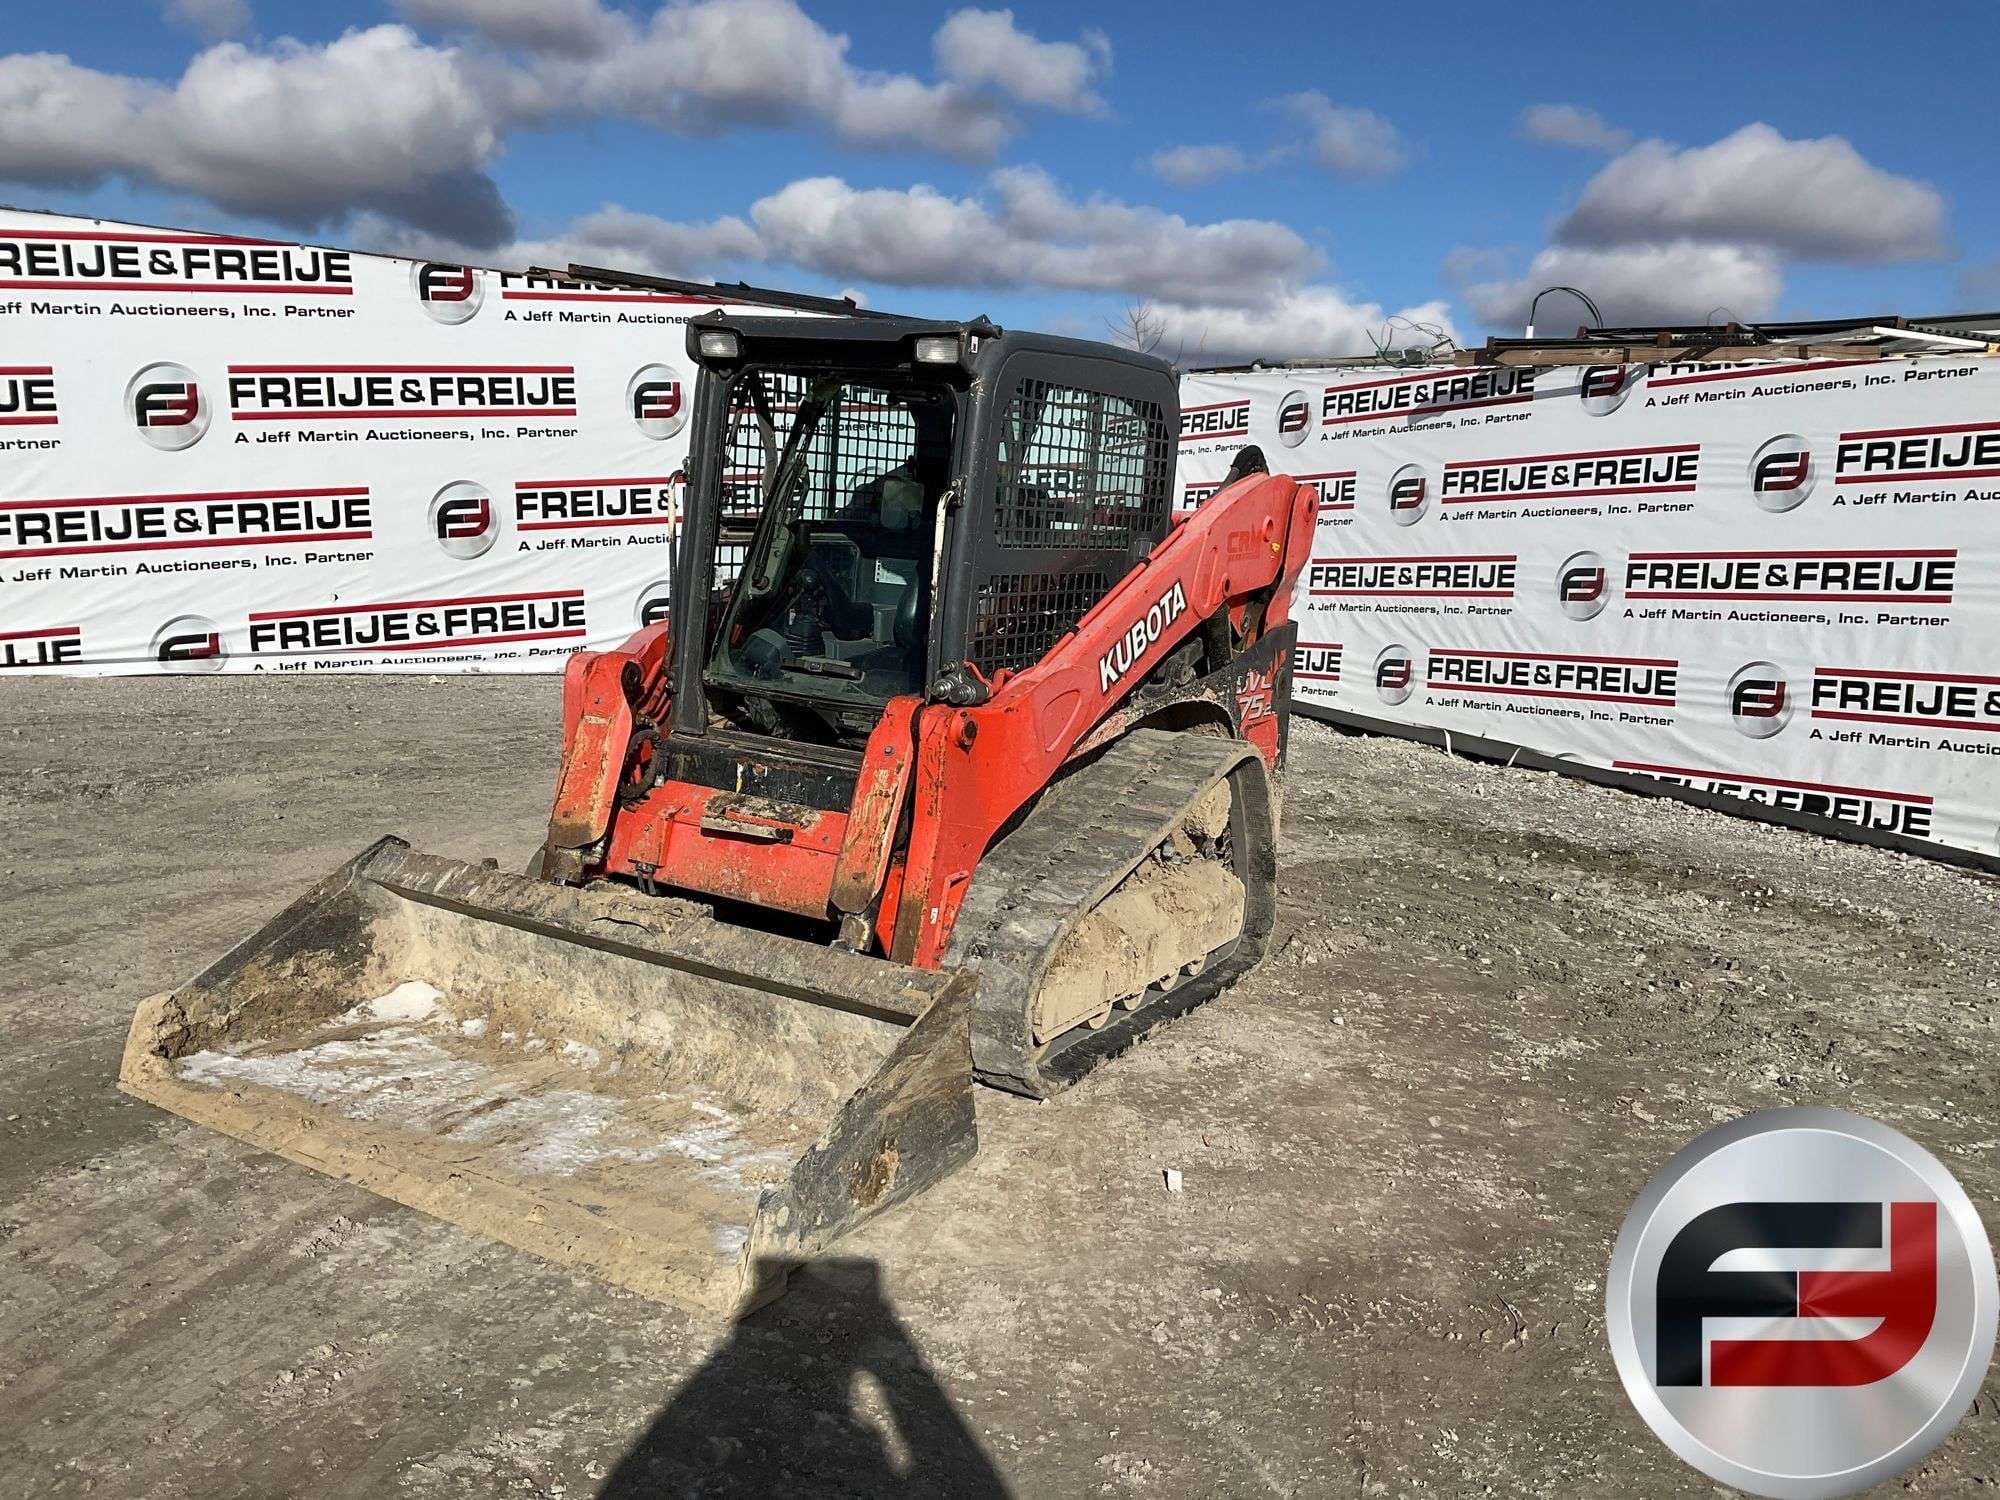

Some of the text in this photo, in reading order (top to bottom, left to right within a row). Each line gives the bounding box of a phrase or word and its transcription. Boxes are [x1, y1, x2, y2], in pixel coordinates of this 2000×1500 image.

[0, 242, 142, 279] REIJE
[0, 301, 356, 319] eff Martin Auctioneers, Inc. Partner
[504, 310, 689, 325] A Jeff Martin Auctionee
[1644, 366, 1979, 408] A Jeff Martin Auctioneers, Inc. Partner
[234, 427, 578, 444] A Jeff Martin Auctioneers, Inc. Partner
[1320, 412, 1532, 442] A Jeff Martin Auctioneers, Inc. Partner
[0, 439, 61, 450] artner
[1832, 494, 1847, 506] A
[1852, 492, 1888, 506] Jeff
[1893, 490, 1957, 504] Martin
[1439, 502, 1695, 522] A Jeff Martin Auctioneers, Inc. Partner
[518, 541, 531, 552] A
[536, 538, 566, 551] Jeff
[571, 537, 621, 549] Martin
[12, 568, 52, 582] Jeff
[59, 564, 128, 579] Martin
[135, 559, 257, 575] Auctioneers,
[265, 555, 297, 567] Inc.
[304, 552, 374, 564] Partner
[1307, 602, 1513, 616] A Jeff Martin Auctioneers, Inc. Partner
[1623, 608, 1950, 627] A Jeff Martin Auctioneers, Inc. Partner
[1099, 581, 1187, 693] KUBOTA
[1301, 686, 1338, 697] Partner
[1425, 696, 1674, 727] A Jeff Martin Auctioneers, Inc. Partner
[1809, 728, 1823, 740] A
[1828, 730, 1863, 743] Jeff
[1868, 733, 1931, 750] Martin
